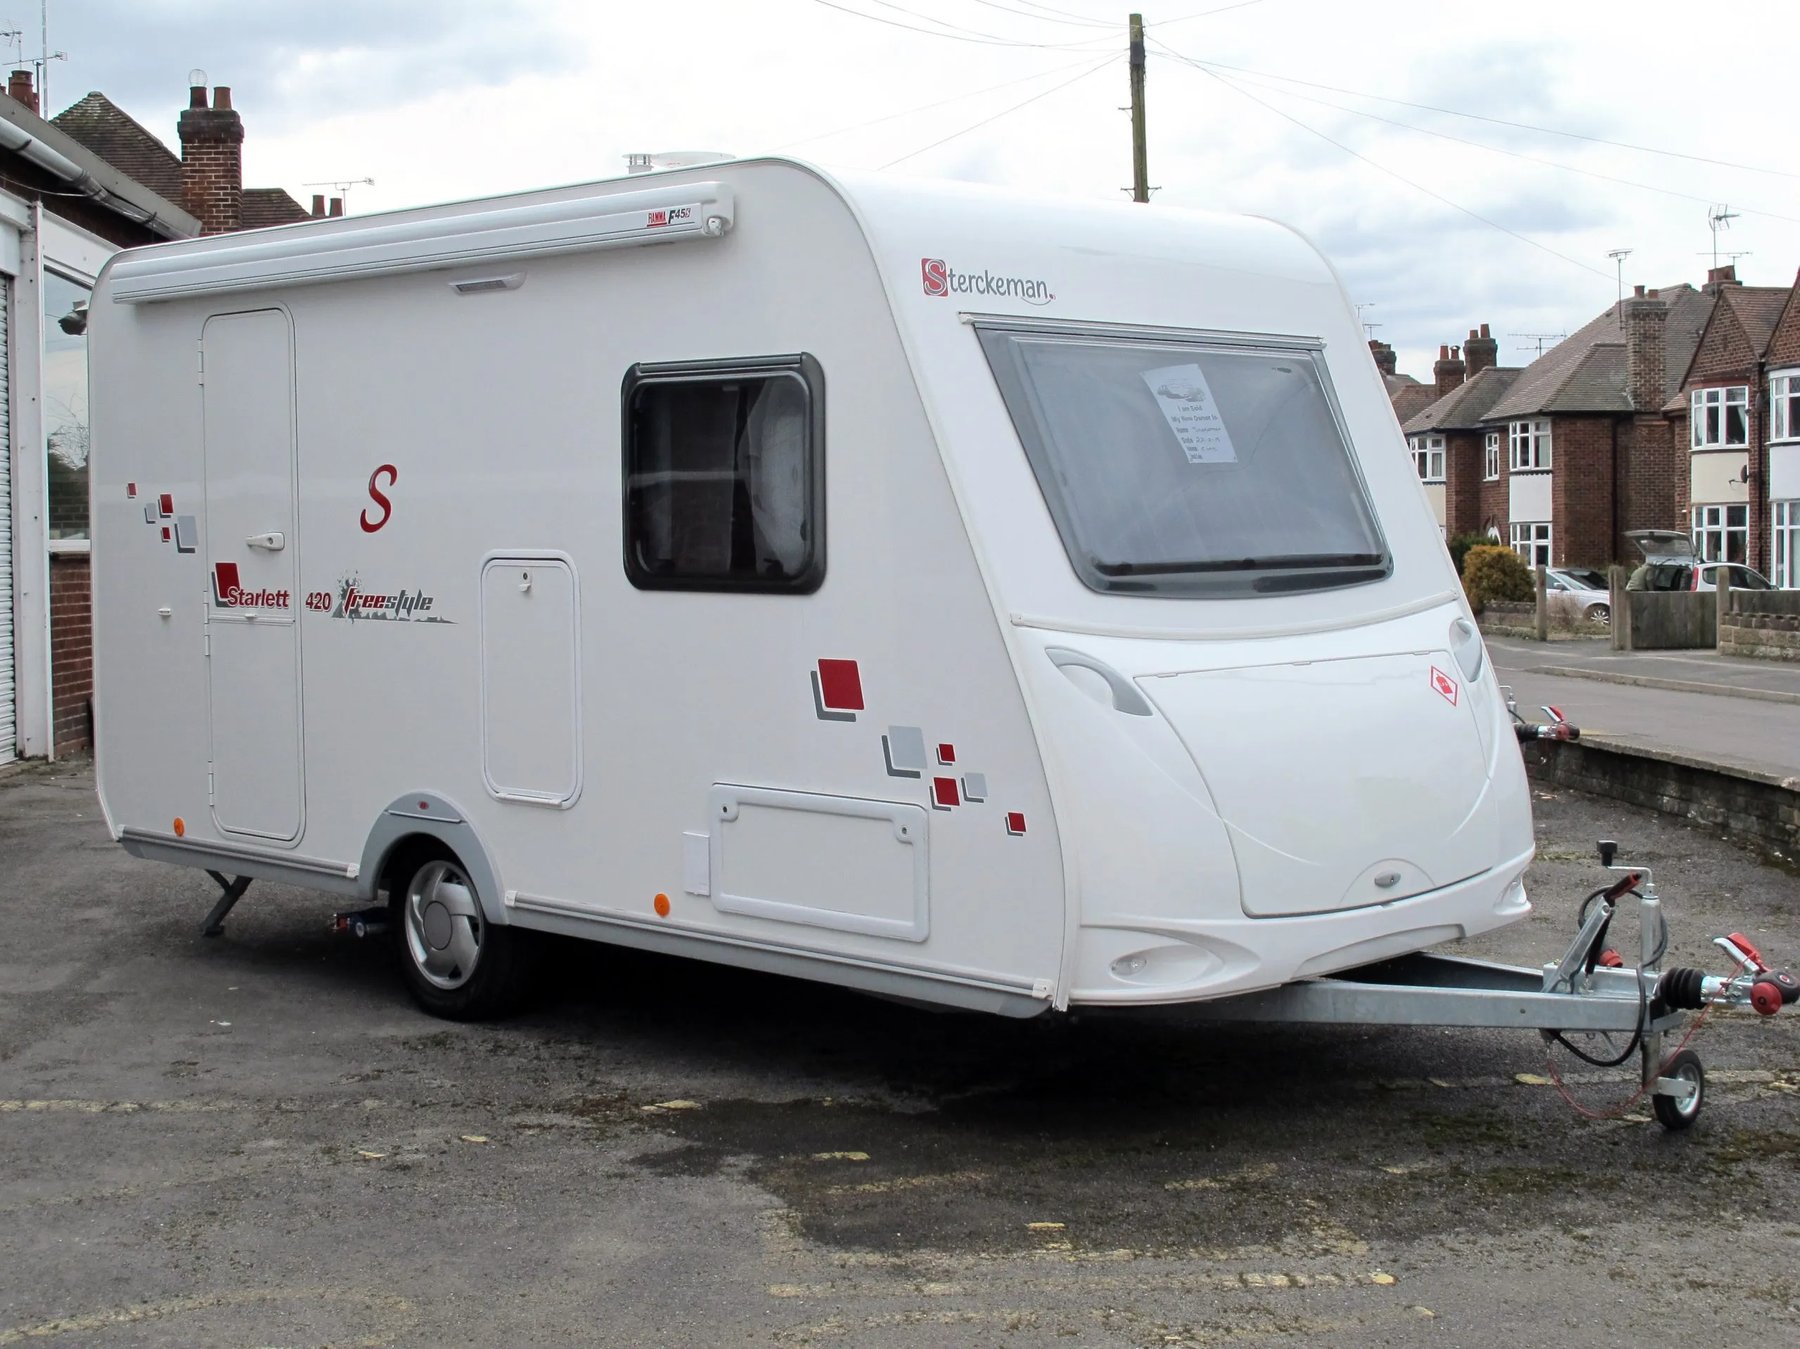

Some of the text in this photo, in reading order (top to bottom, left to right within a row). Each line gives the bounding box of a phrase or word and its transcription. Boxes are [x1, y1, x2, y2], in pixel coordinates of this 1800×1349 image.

[360, 464, 398, 533] S
[227, 586, 290, 609] Starlett
[305, 591, 332, 612] 420
